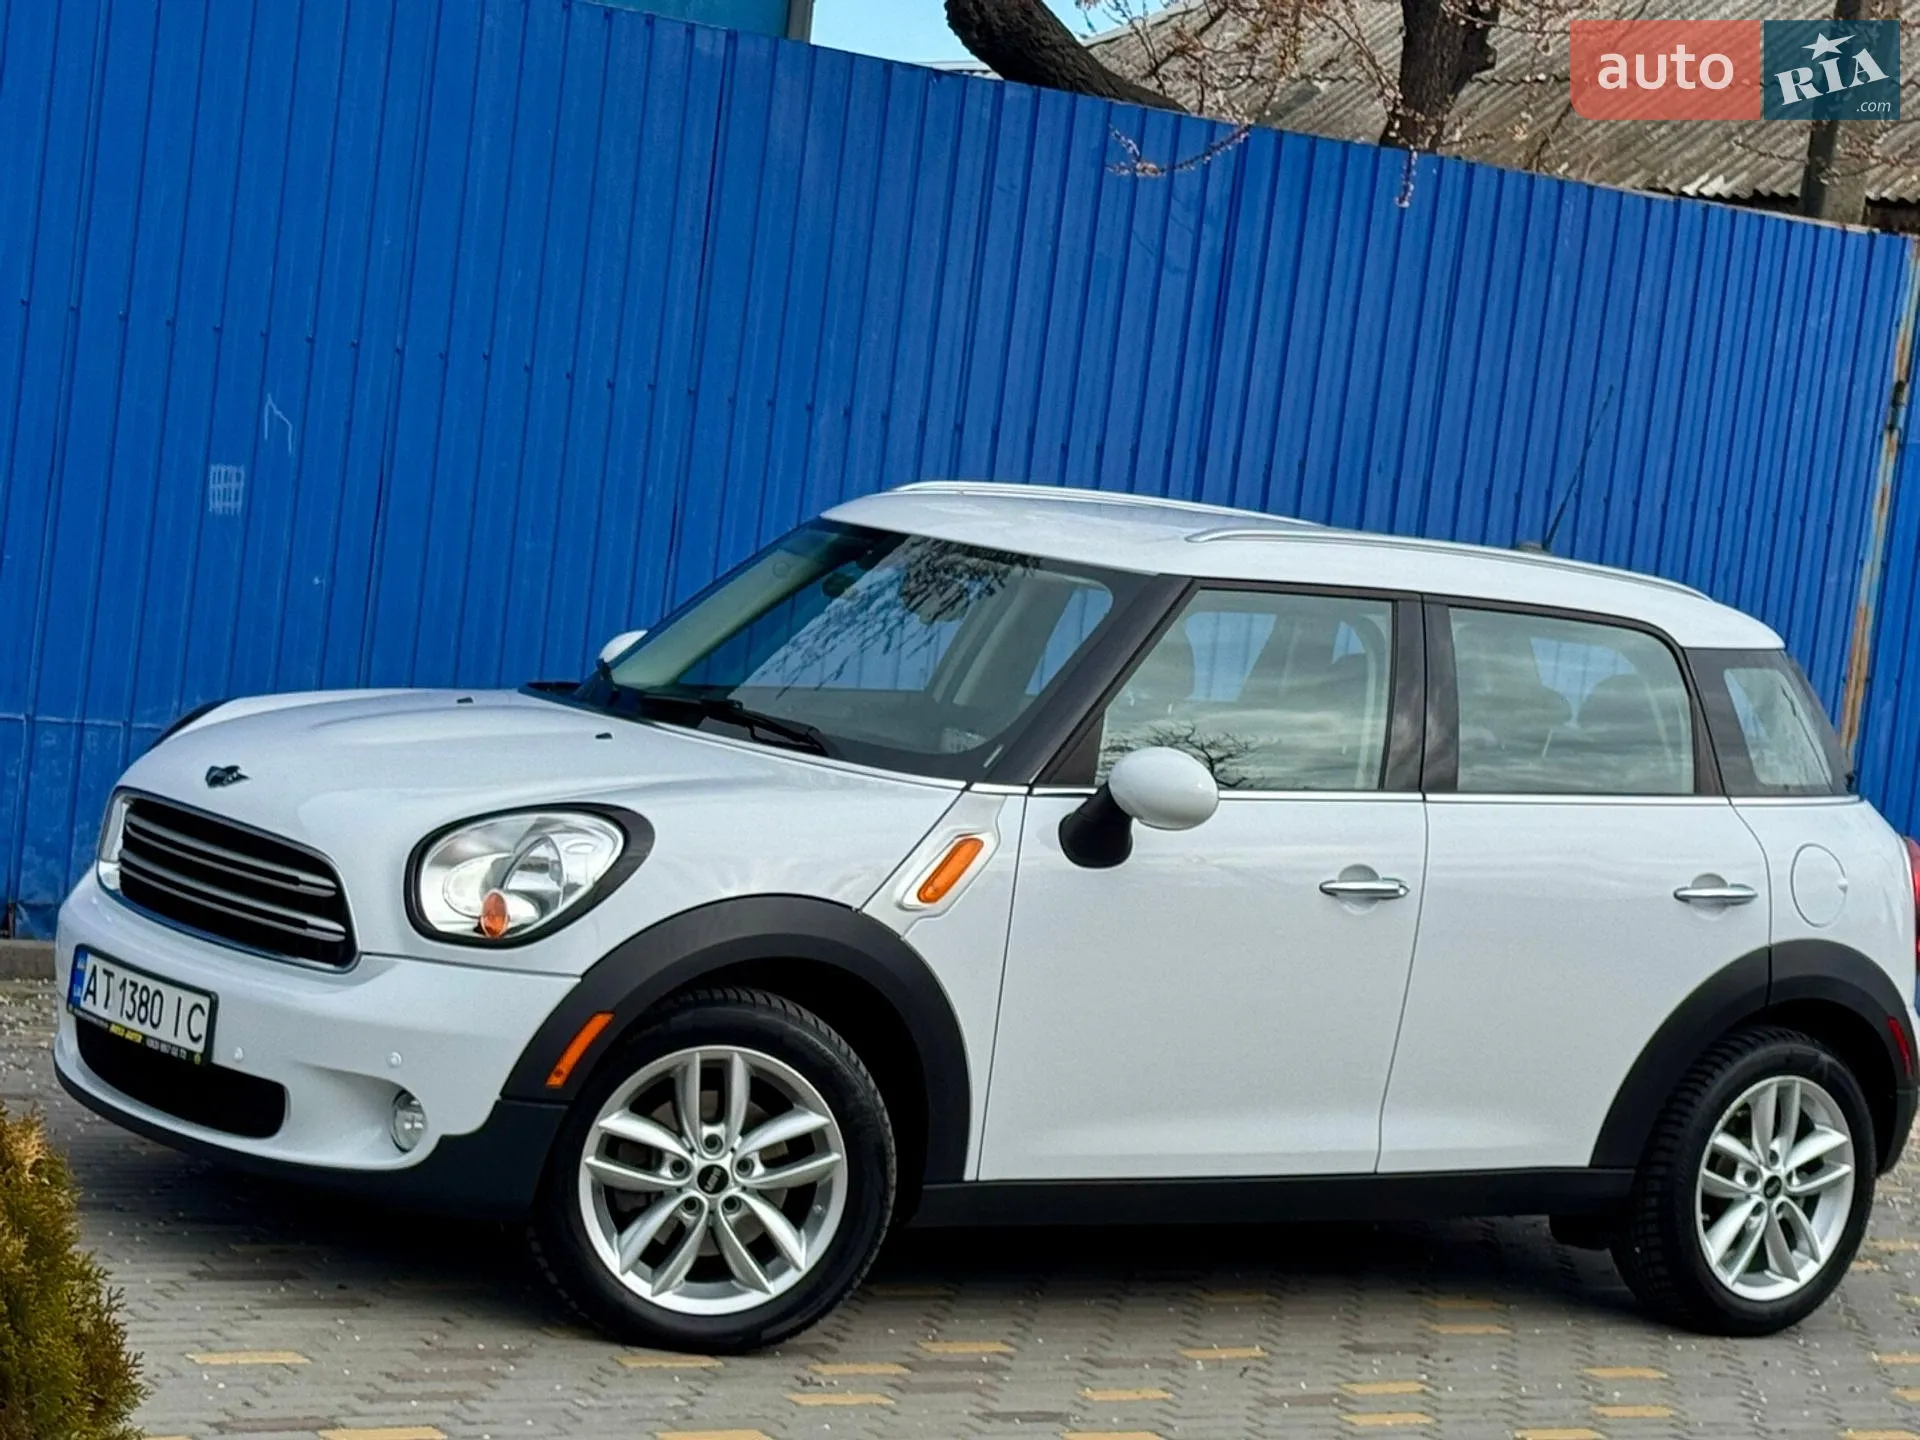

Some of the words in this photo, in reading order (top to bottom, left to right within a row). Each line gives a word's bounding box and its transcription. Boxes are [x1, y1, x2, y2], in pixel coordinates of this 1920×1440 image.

[83, 964, 115, 1010] AT
[119, 977, 164, 1030] 1380
[174, 996, 206, 1044] IC
